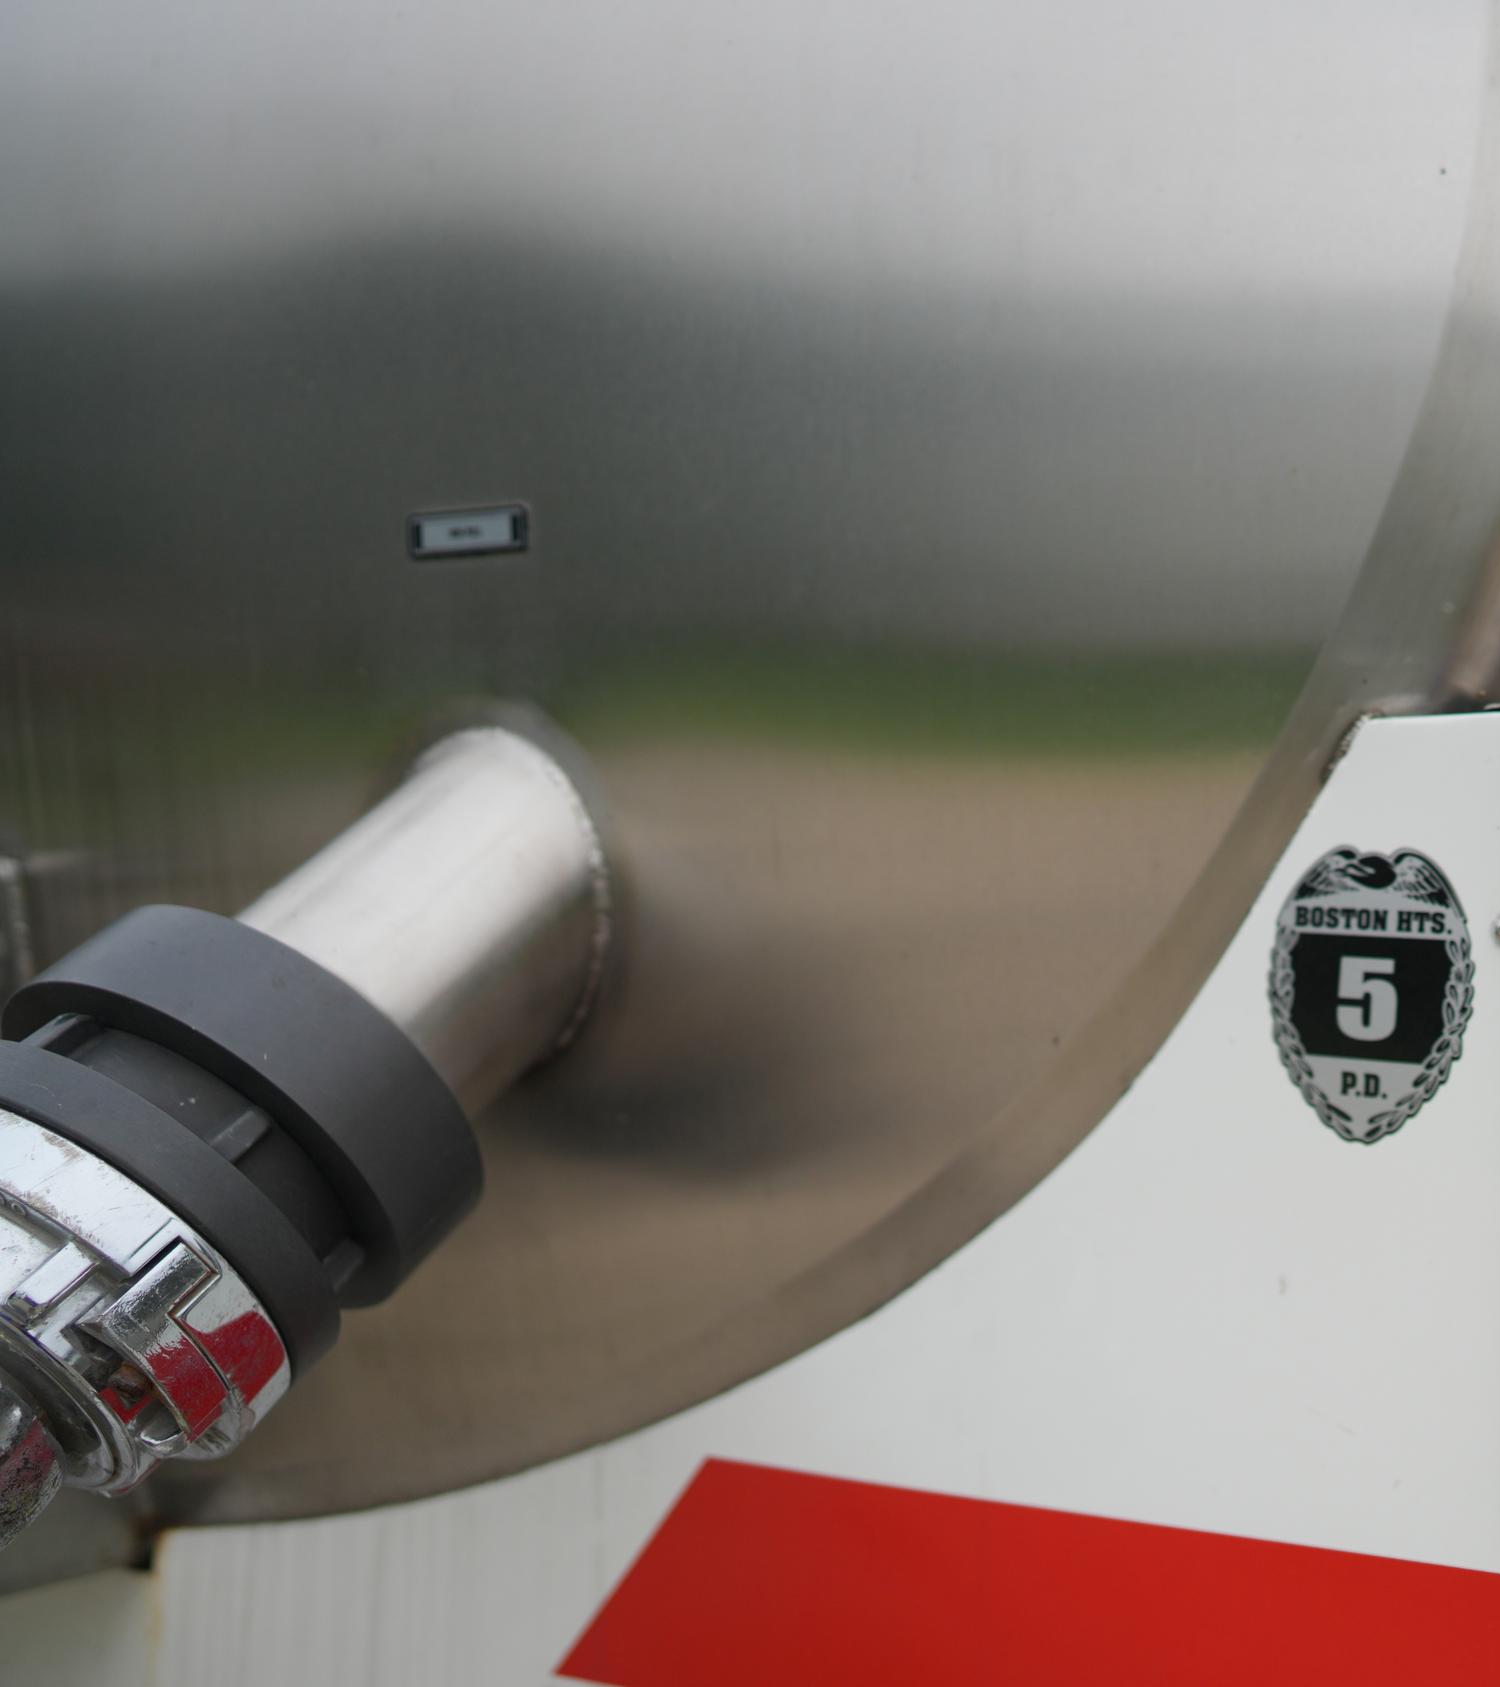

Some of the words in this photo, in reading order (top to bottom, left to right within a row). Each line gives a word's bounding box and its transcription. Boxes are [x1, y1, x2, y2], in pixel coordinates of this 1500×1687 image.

[1296, 906, 1388, 931] BOSTON
[1397, 911, 1453, 935] HTS.
[1336, 955, 1398, 1041] 5
[1341, 1071, 1388, 1099] P.D.
